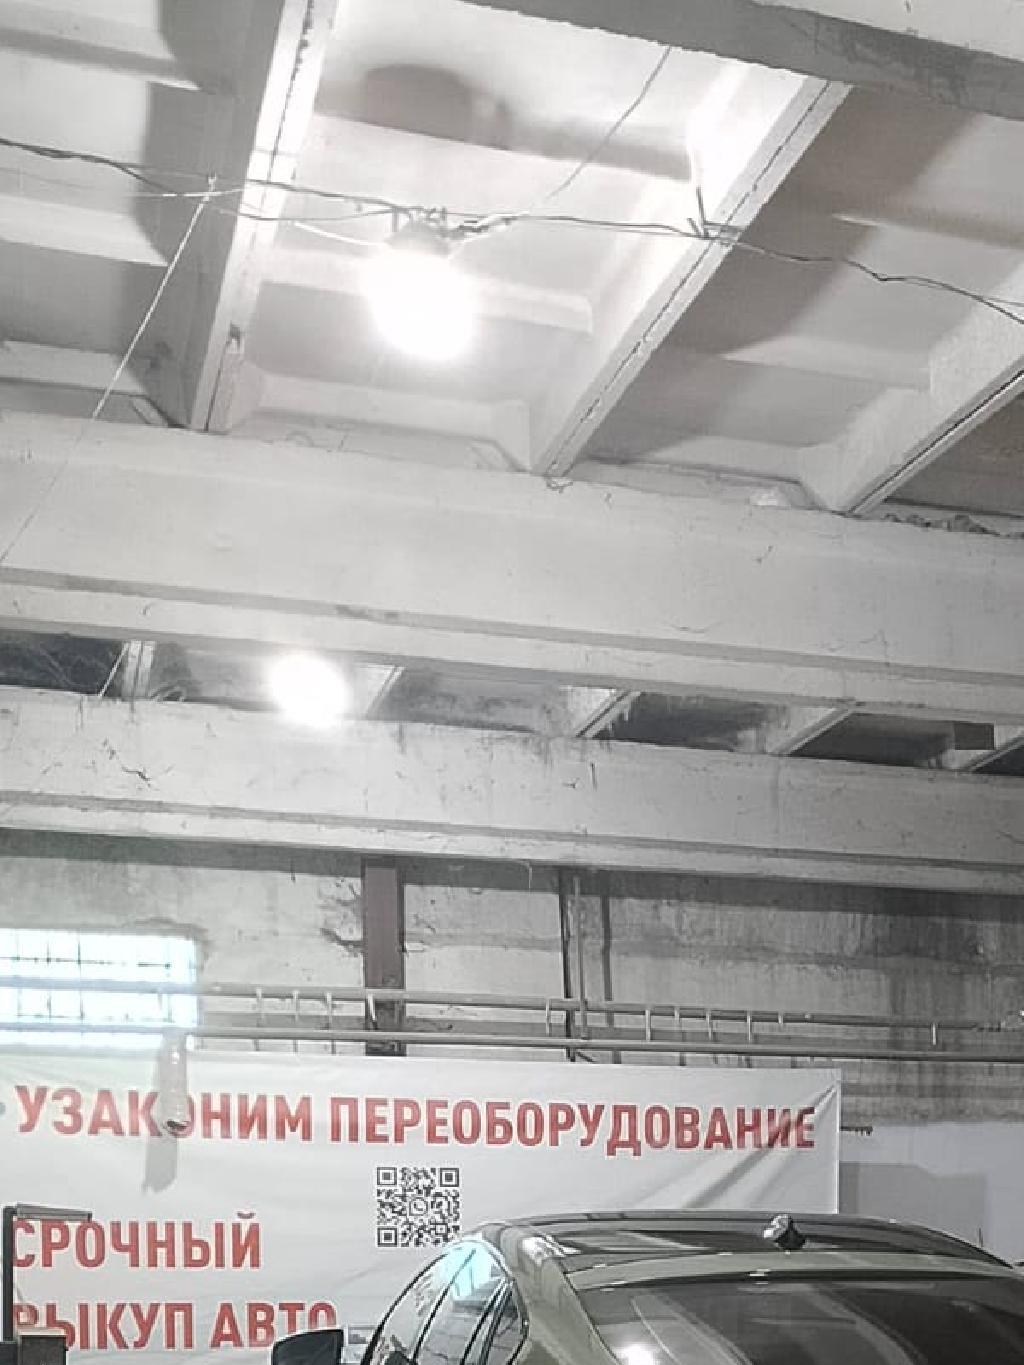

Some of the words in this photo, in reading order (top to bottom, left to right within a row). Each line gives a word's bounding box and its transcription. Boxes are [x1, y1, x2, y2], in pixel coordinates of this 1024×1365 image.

[15, 1086, 312, 1142] УЗАКНИМ
[329, 1098, 815, 1156] ПЕРЕОБОРУДОВАНИЕ
[13, 1212, 261, 1269] СРОЧНЫЙ
